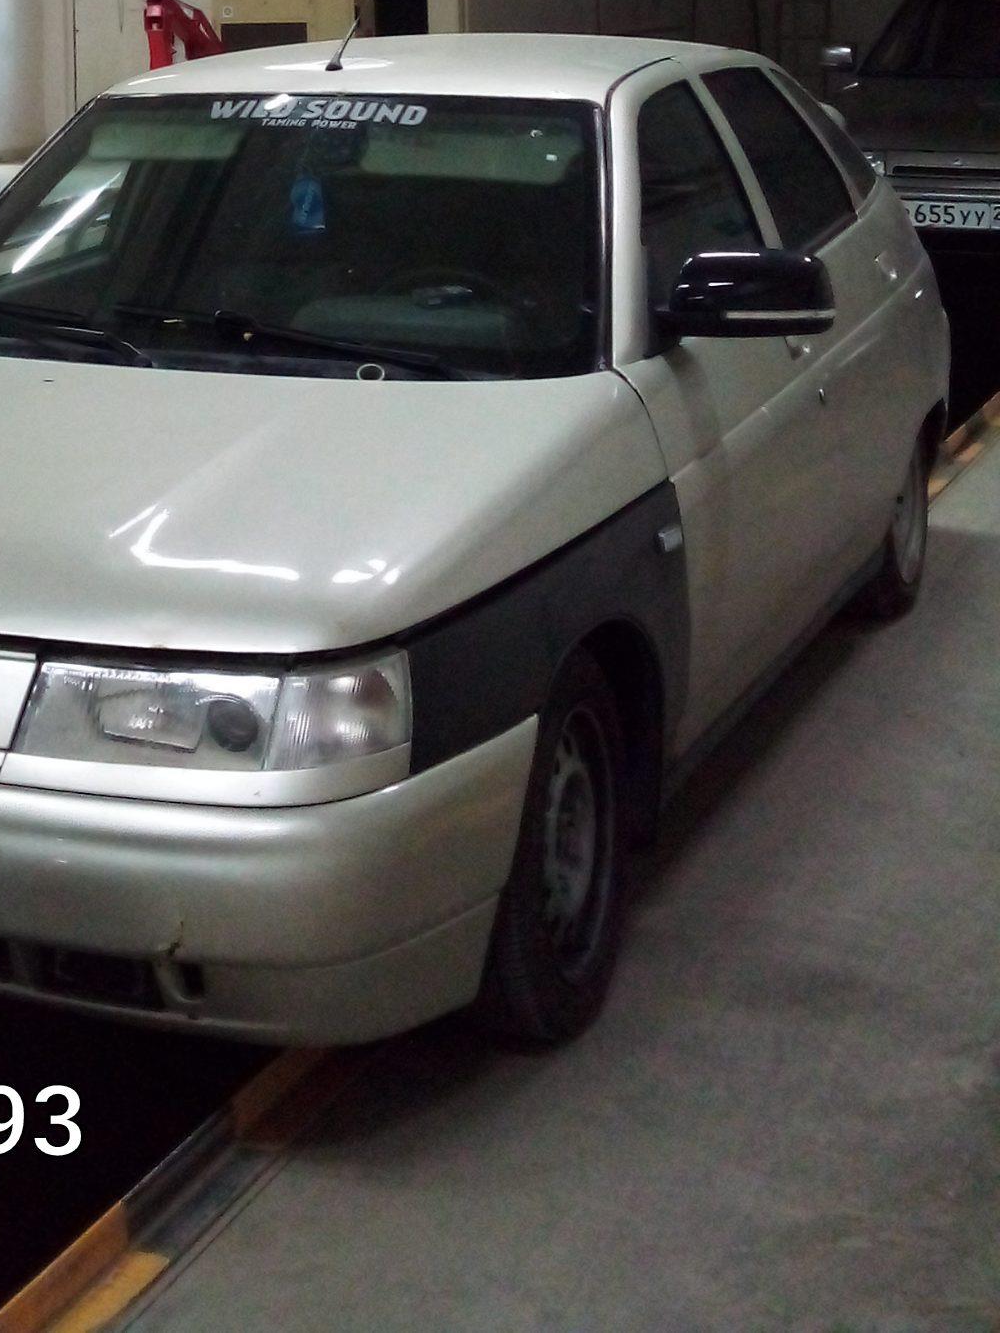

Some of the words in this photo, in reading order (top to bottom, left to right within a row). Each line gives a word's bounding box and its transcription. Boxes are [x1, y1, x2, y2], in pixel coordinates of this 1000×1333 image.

[261, 118, 307, 127] TAMING
[311, 119, 358, 129] POWER
[302, 99, 428, 126] SOUND
[905, 203, 985, 226] 655УУ
